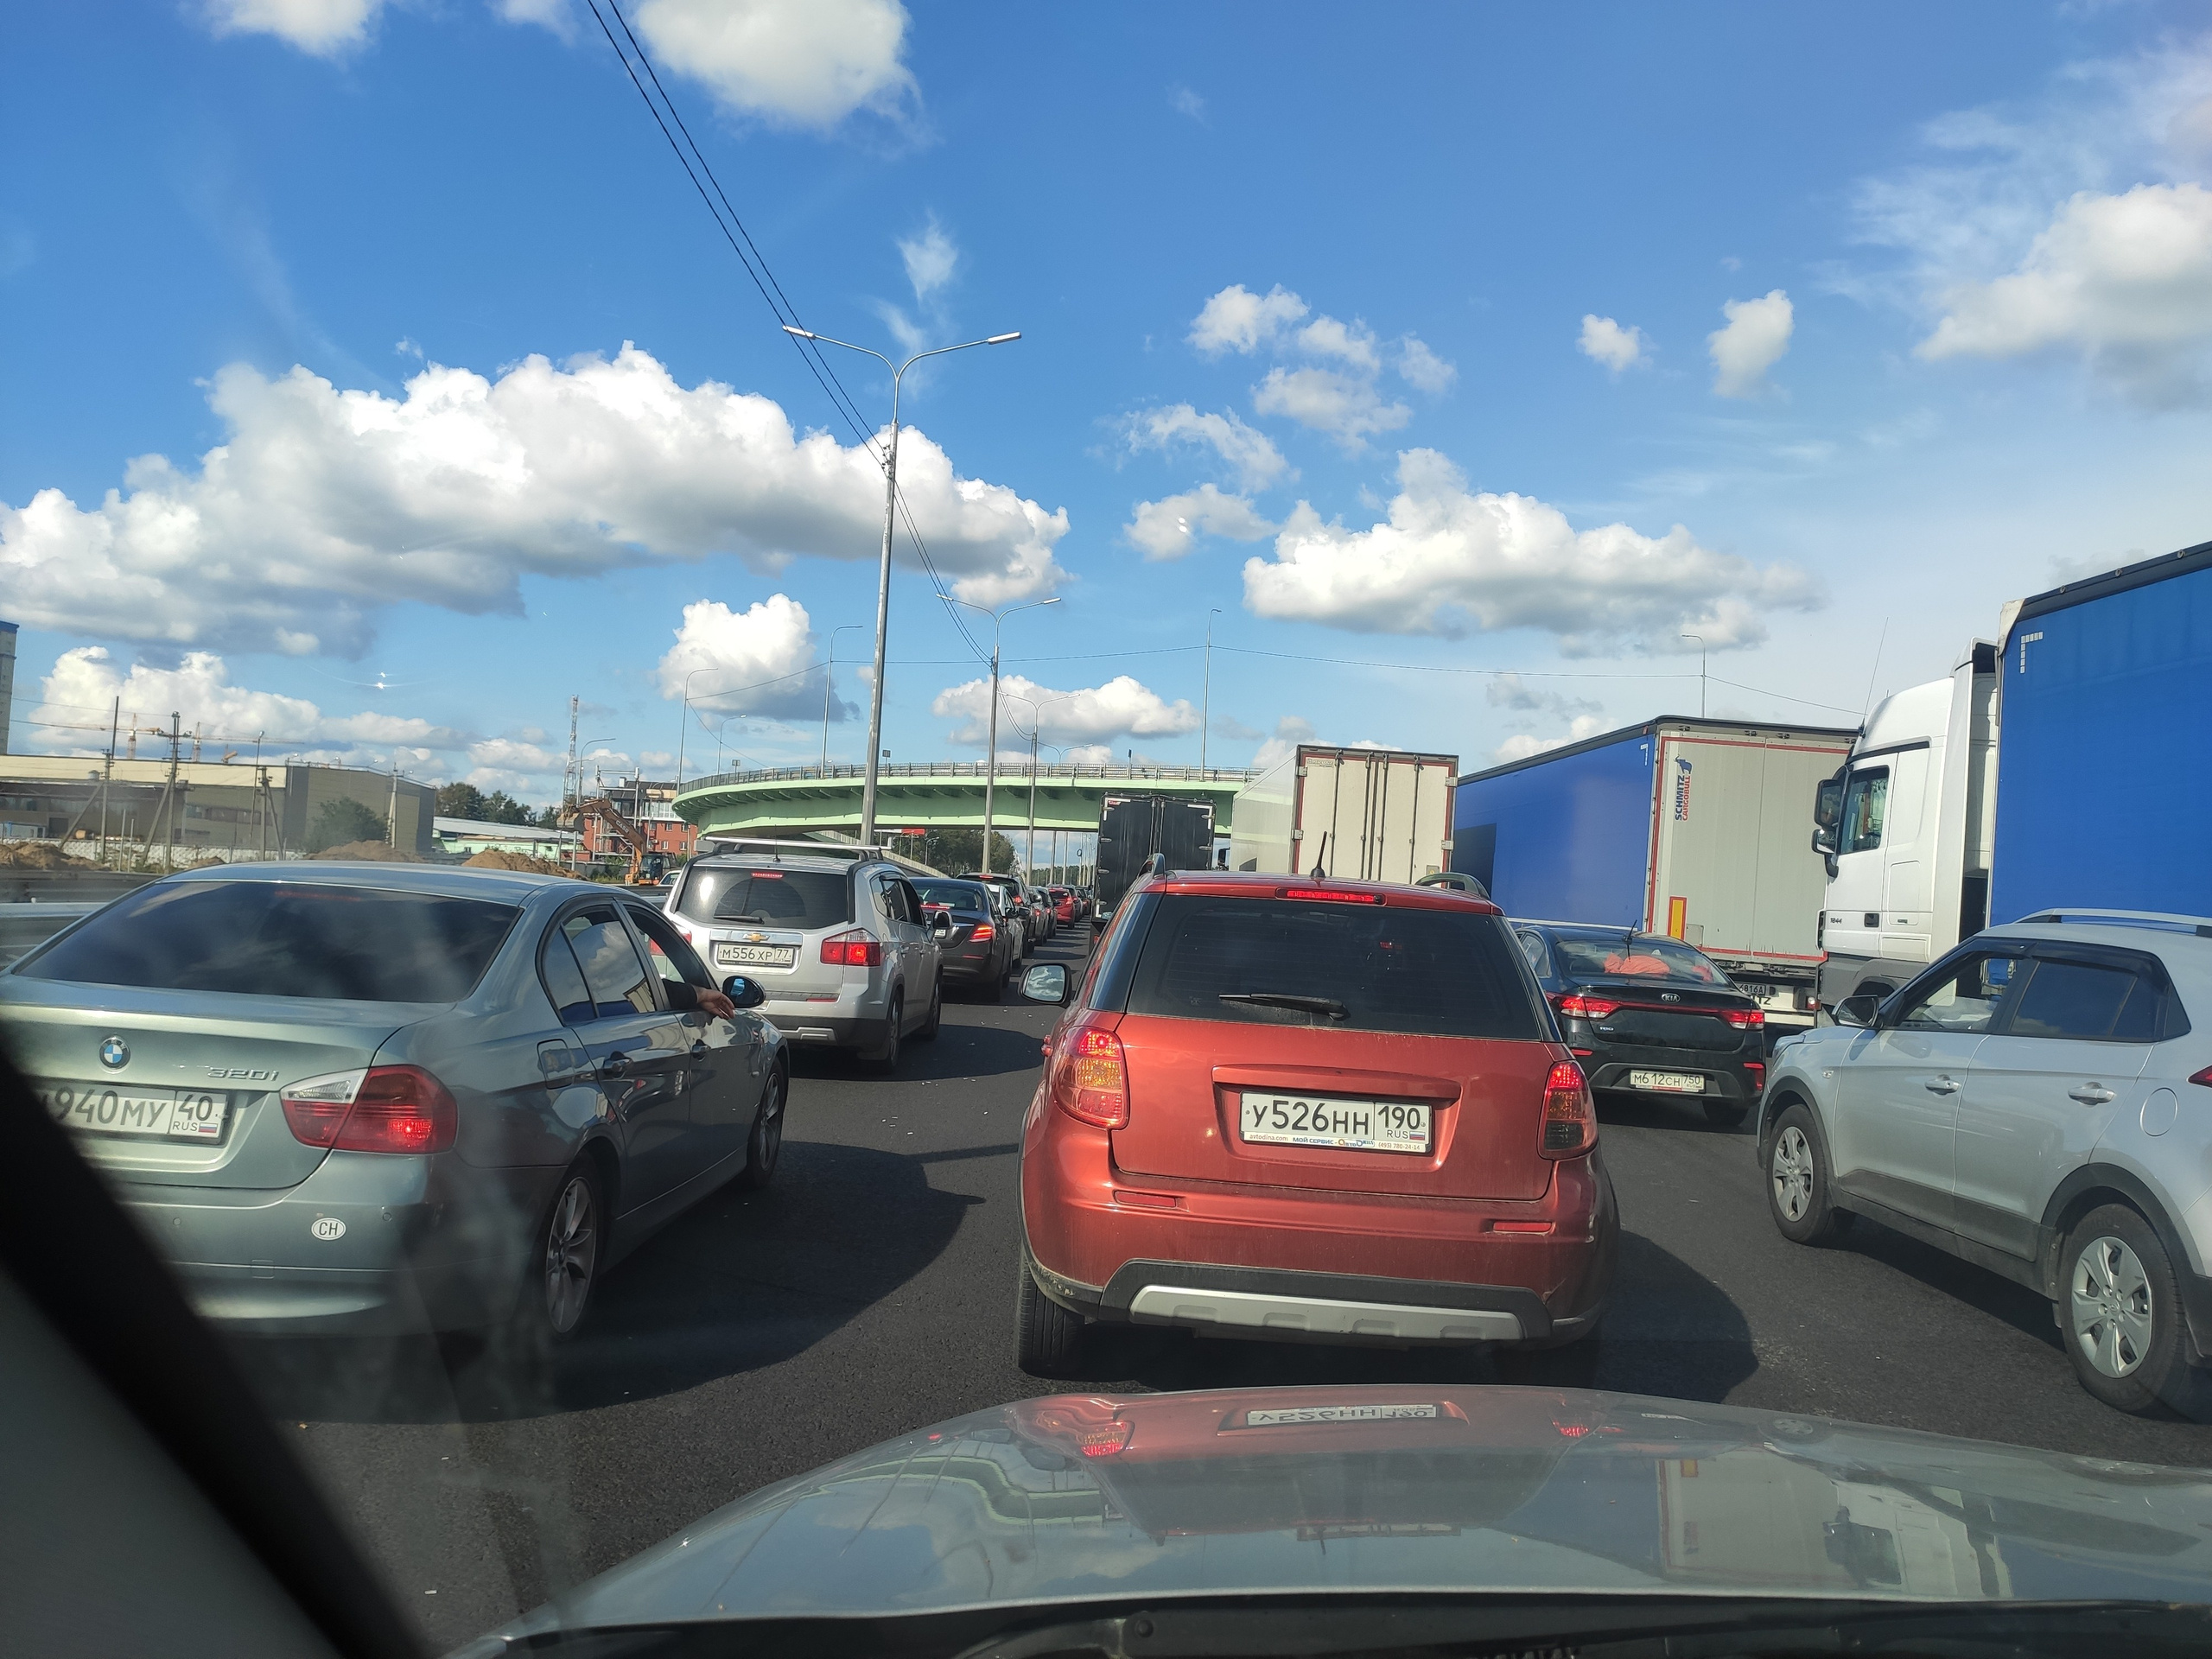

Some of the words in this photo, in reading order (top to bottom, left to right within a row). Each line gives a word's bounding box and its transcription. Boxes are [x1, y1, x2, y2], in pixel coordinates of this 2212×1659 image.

[1675, 774, 1684, 820] SCHMITZ
[722, 947, 772, 961] М556ХР
[777, 949, 789, 958] 77
[207, 1066, 279, 1081] 320i
[1634, 1072, 1681, 1086] М612СН
[1682, 1074, 1700, 1084] 750
[178, 1093, 213, 1122] 40
[1252, 1099, 1370, 1135] У526НН
[1377, 1105, 1421, 1130] 190
[172, 1121, 198, 1132] RUS
[1387, 1129, 1408, 1139] RUS
[320, 1222, 338, 1236] CH
